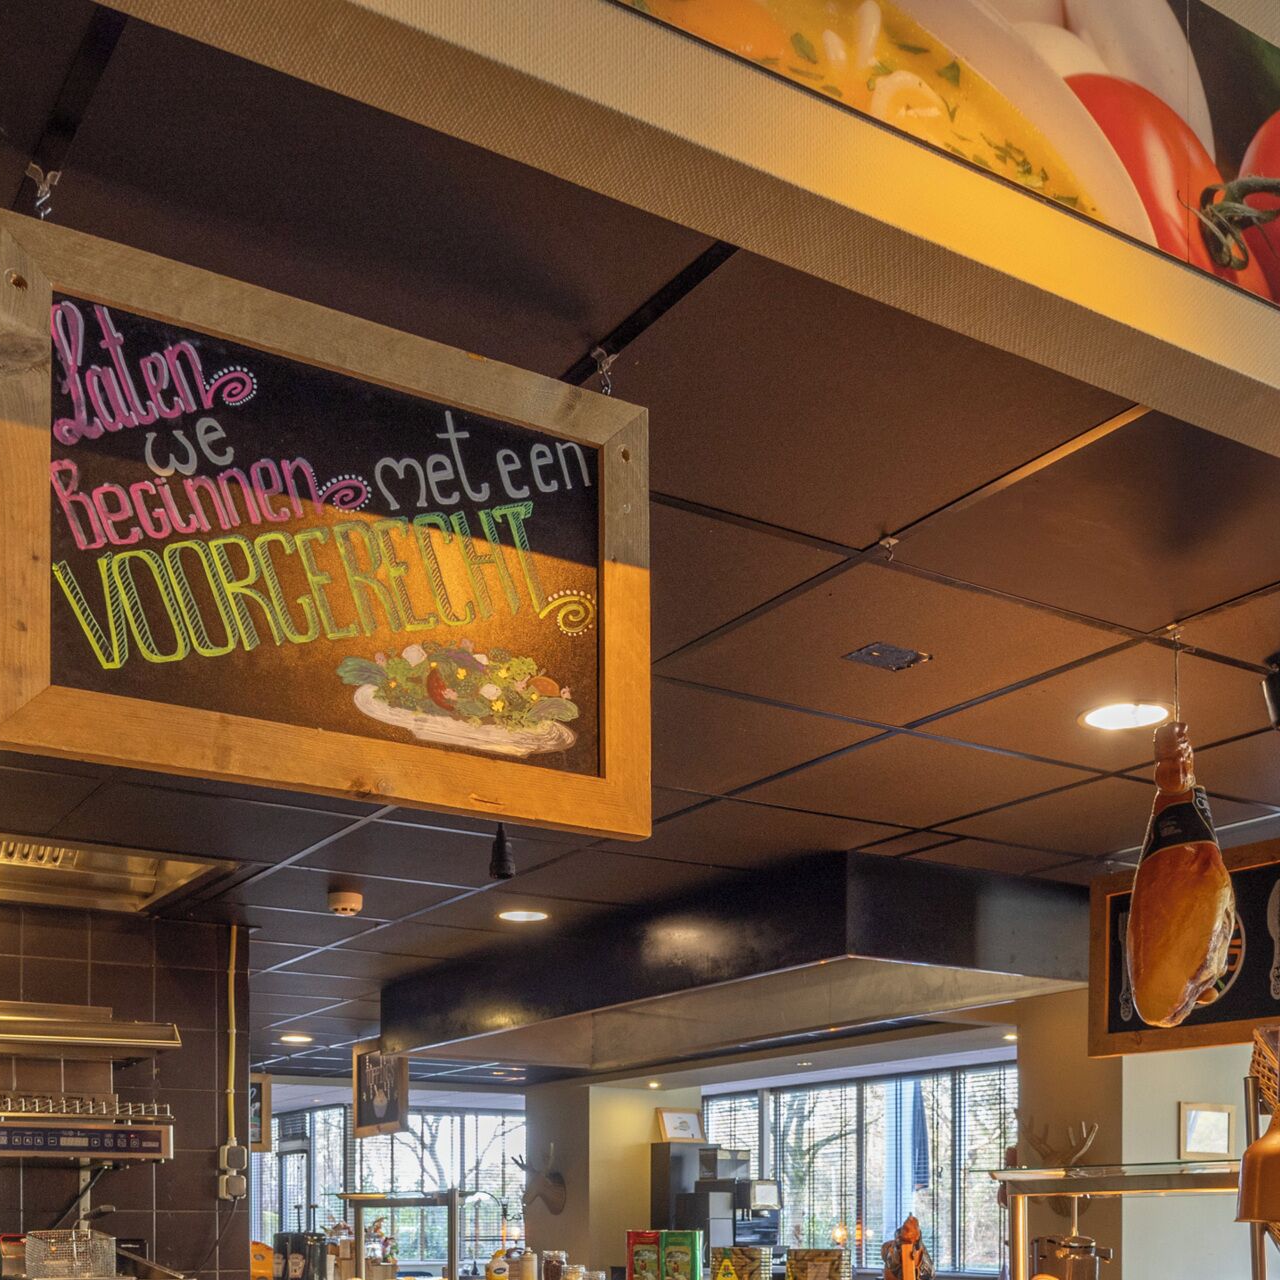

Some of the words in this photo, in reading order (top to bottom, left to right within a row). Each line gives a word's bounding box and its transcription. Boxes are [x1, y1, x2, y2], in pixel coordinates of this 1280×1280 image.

[51, 301, 214, 445] Laten
[144, 417, 234, 476] we
[372, 411, 488, 510] met
[496, 440, 591, 498] een
[53, 502, 544, 669] VOORGERECHT
